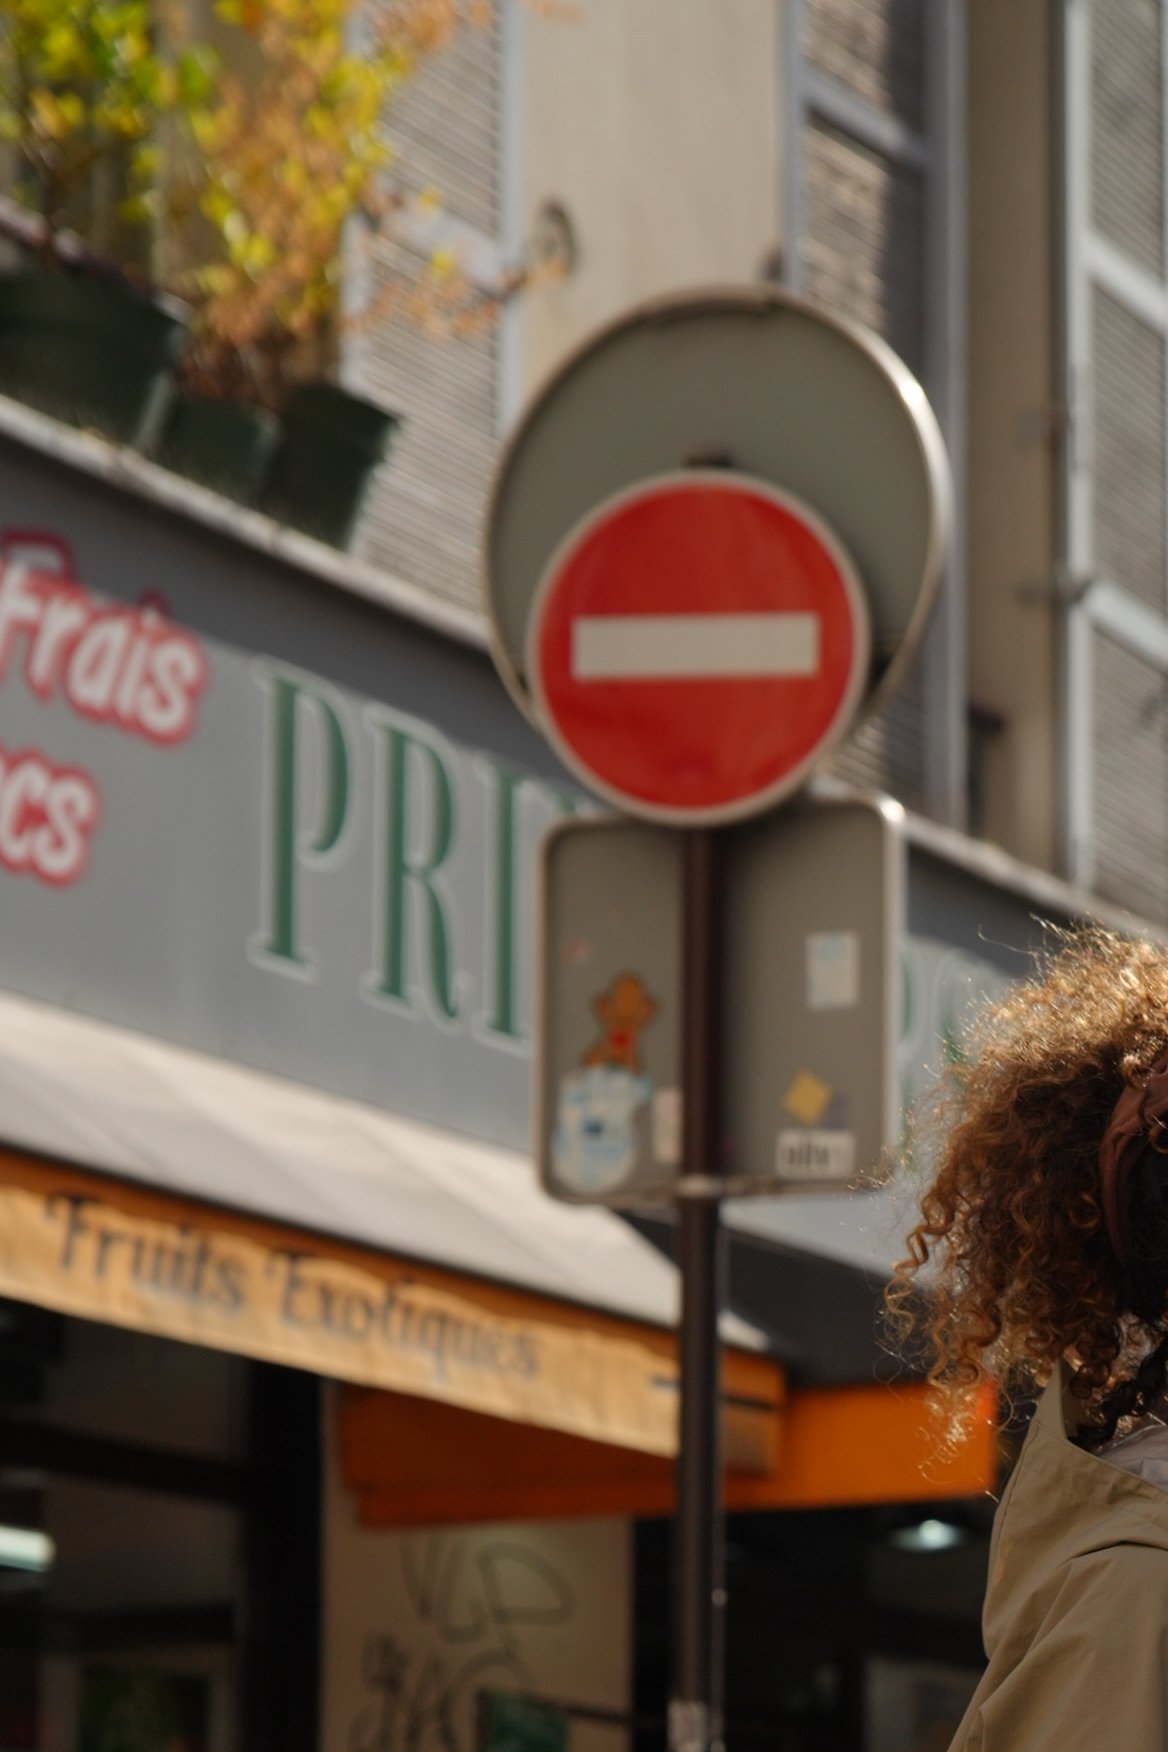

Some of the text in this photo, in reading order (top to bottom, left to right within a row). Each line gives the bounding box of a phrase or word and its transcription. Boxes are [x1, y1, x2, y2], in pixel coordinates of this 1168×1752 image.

[0, 530, 208, 744] Frais
[0, 748, 102, 886] cs
[252, 658, 585, 1056] PRI
[45, 1192, 542, 1386] Fruits Exotiques
